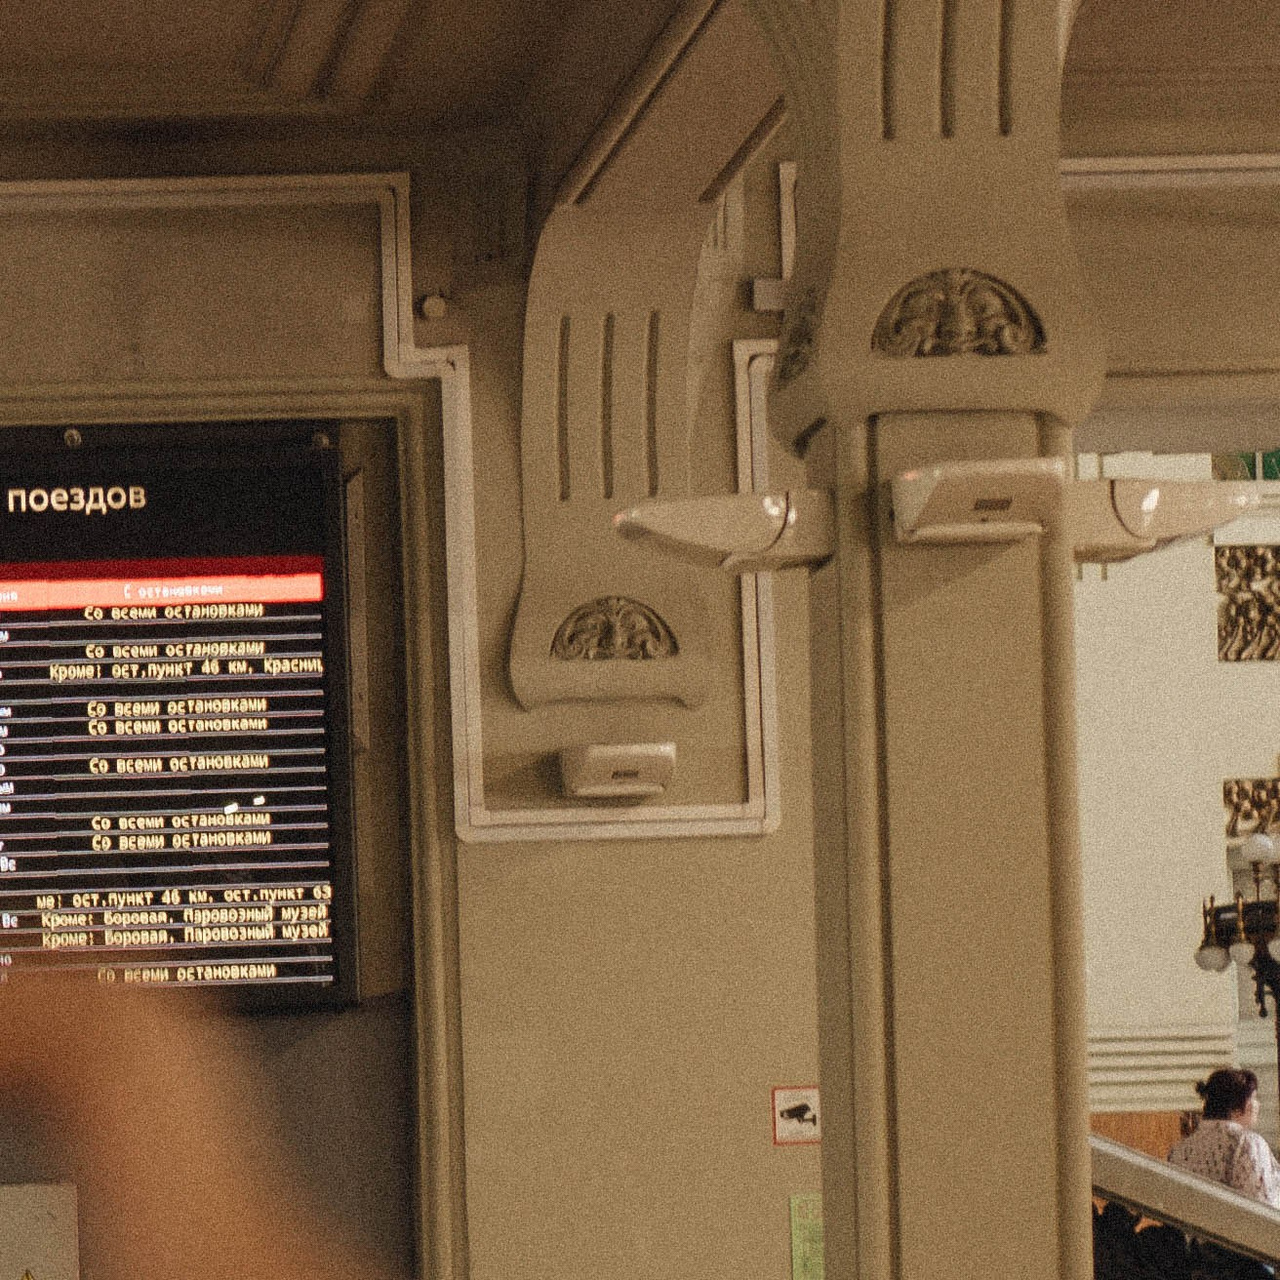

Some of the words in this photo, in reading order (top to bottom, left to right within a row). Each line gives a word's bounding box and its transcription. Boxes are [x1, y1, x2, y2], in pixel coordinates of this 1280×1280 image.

[8, 486, 146, 514] поездов
[84, 606, 103, 621] Со
[111, 607, 157, 620] всеми
[164, 604, 263, 619] остановками
[85, 644, 105, 659] Со
[112, 645, 158, 658] всеми
[165, 642, 264, 657] остановками
[49, 664, 101, 683] Кроме:
[201, 659, 220, 675] 46
[87, 700, 106, 718] Со
[114, 702, 160, 717] всеми
[167, 698, 267, 716] остановками
[88, 718, 107, 736] Со
[115, 720, 161, 735] всеми
[168, 718, 267, 734] остановками
[89, 757, 109, 774] Со
[116, 758, 162, 774] всеми
[169, 754, 269, 772] остановками
[91, 815, 111, 831] Со
[118, 817, 164, 830] всеми
[172, 813, 270, 827] остановками
[92, 834, 111, 852] Со
[119, 835, 165, 851] всеми
[172, 831, 271, 849] остановками
[161, 888, 180, 905] 46
[41, 912, 93, 931] Кроме:
[184, 907, 272, 926] Паровозный
[282, 905, 326, 923] музей
[42, 933, 93, 950] Кроме:
[184, 925, 273, 944] Паровозный
[282, 921, 328, 942] музей
[177, 964, 276, 981] остановками
